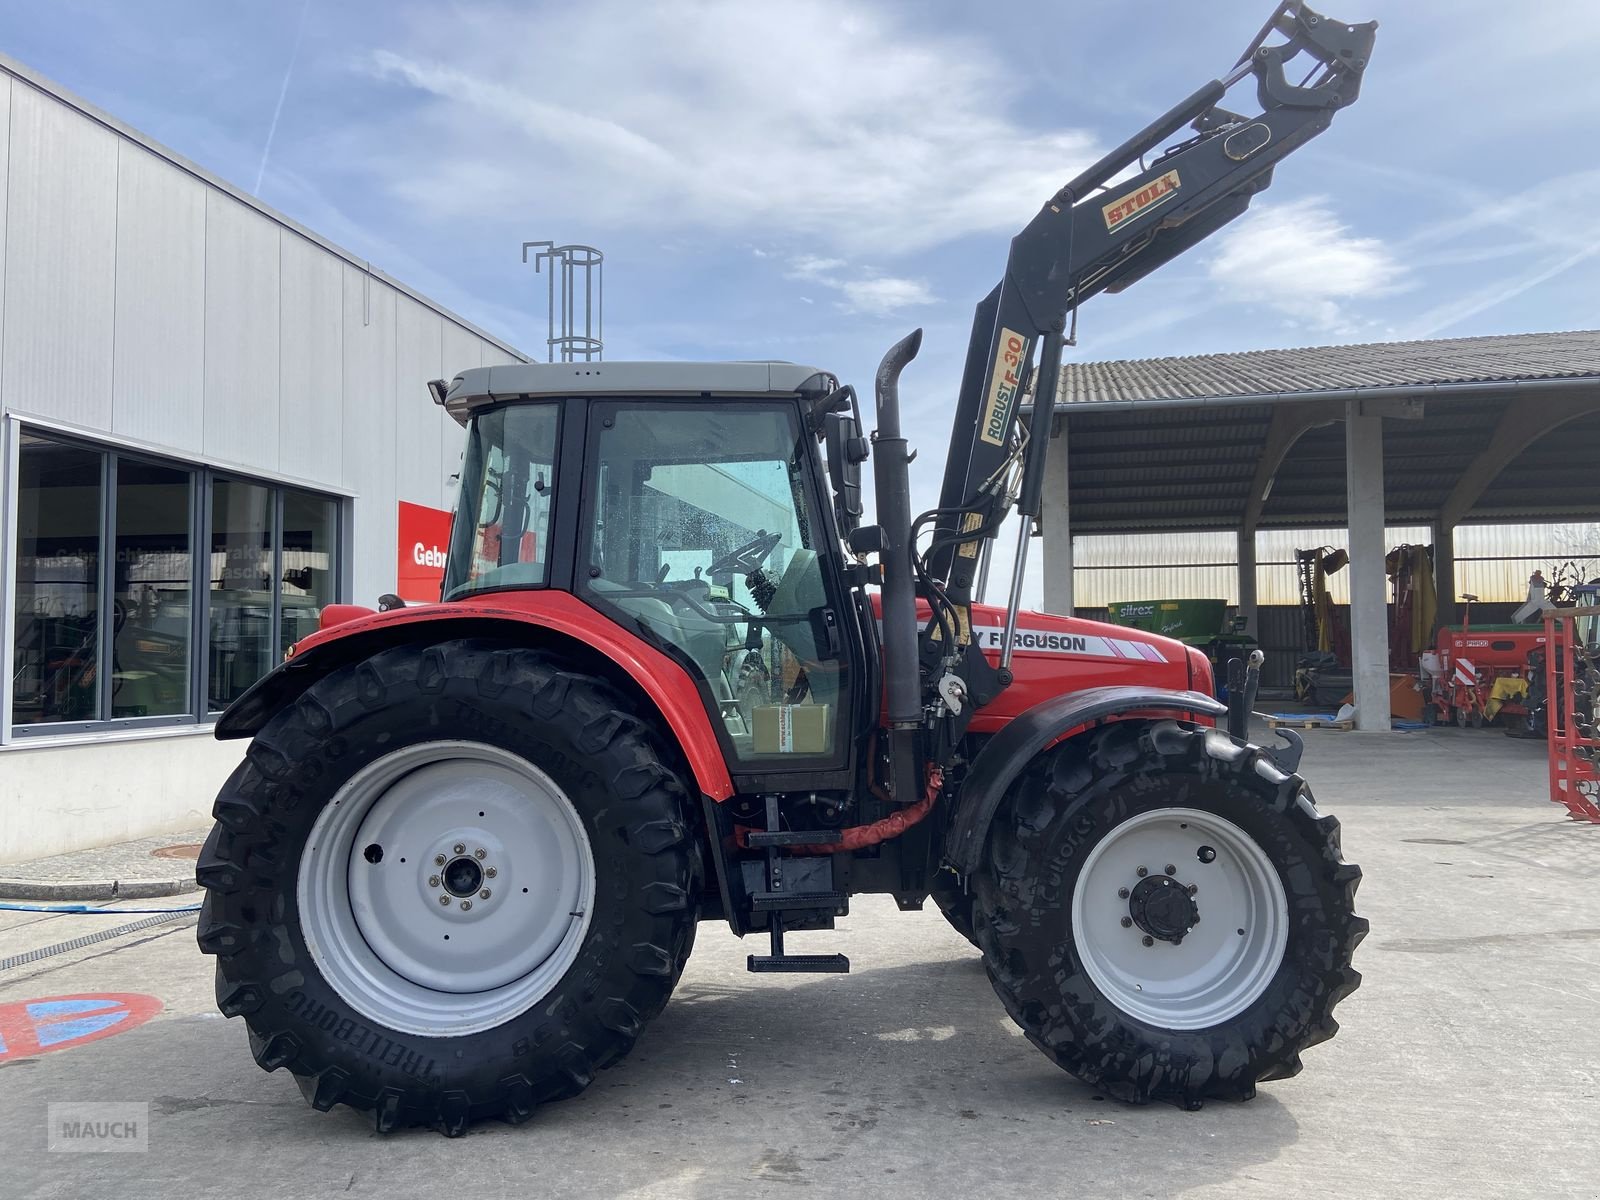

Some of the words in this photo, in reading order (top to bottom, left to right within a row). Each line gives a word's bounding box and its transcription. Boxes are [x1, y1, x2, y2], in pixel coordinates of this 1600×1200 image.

[1004, 336, 1021, 367] 30
[1004, 370, 1018, 386] F
[987, 382, 1011, 440] ROBUST
[1120, 604, 1154, 617] sitrex
[989, 632, 1086, 651] FRGUSON
[282, 990, 440, 1083] TRELLEBORG
